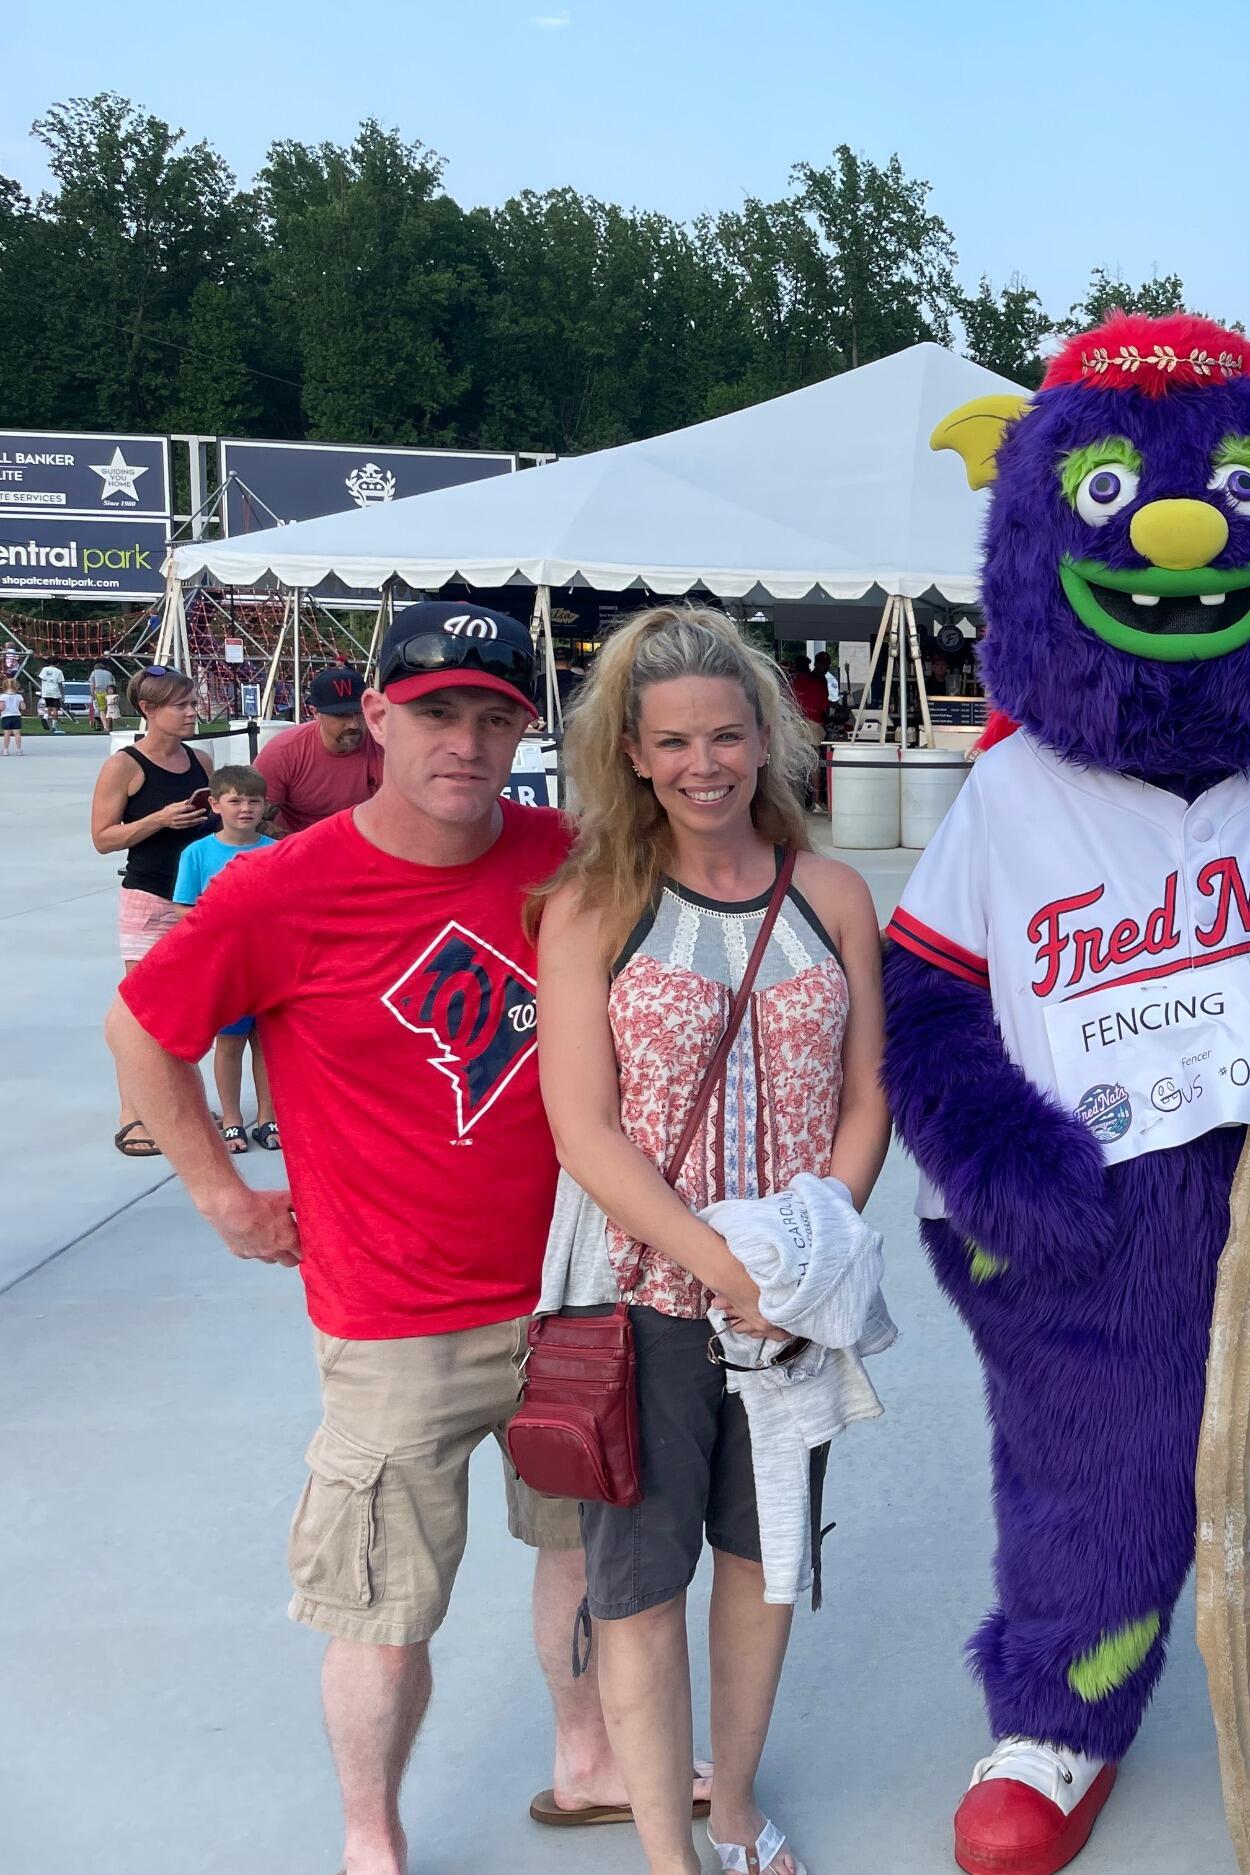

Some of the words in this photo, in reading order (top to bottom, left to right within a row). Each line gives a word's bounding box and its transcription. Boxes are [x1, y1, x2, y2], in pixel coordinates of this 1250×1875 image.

[0, 452, 12, 463] L
[16, 452, 75, 466] BANKER
[0, 470, 23, 481] ITE
[101, 468, 135, 476] GUIDING
[13, 493, 63, 502] SERVICES
[83, 543, 152, 574] park
[2, 575, 120, 588] shopatcentralpark.com
[332, 679, 352, 697] W
[1027, 870, 1181, 998] Fred
[1081, 992, 1225, 1052] FENCING
[1181, 1050, 1212, 1067] Fencer
